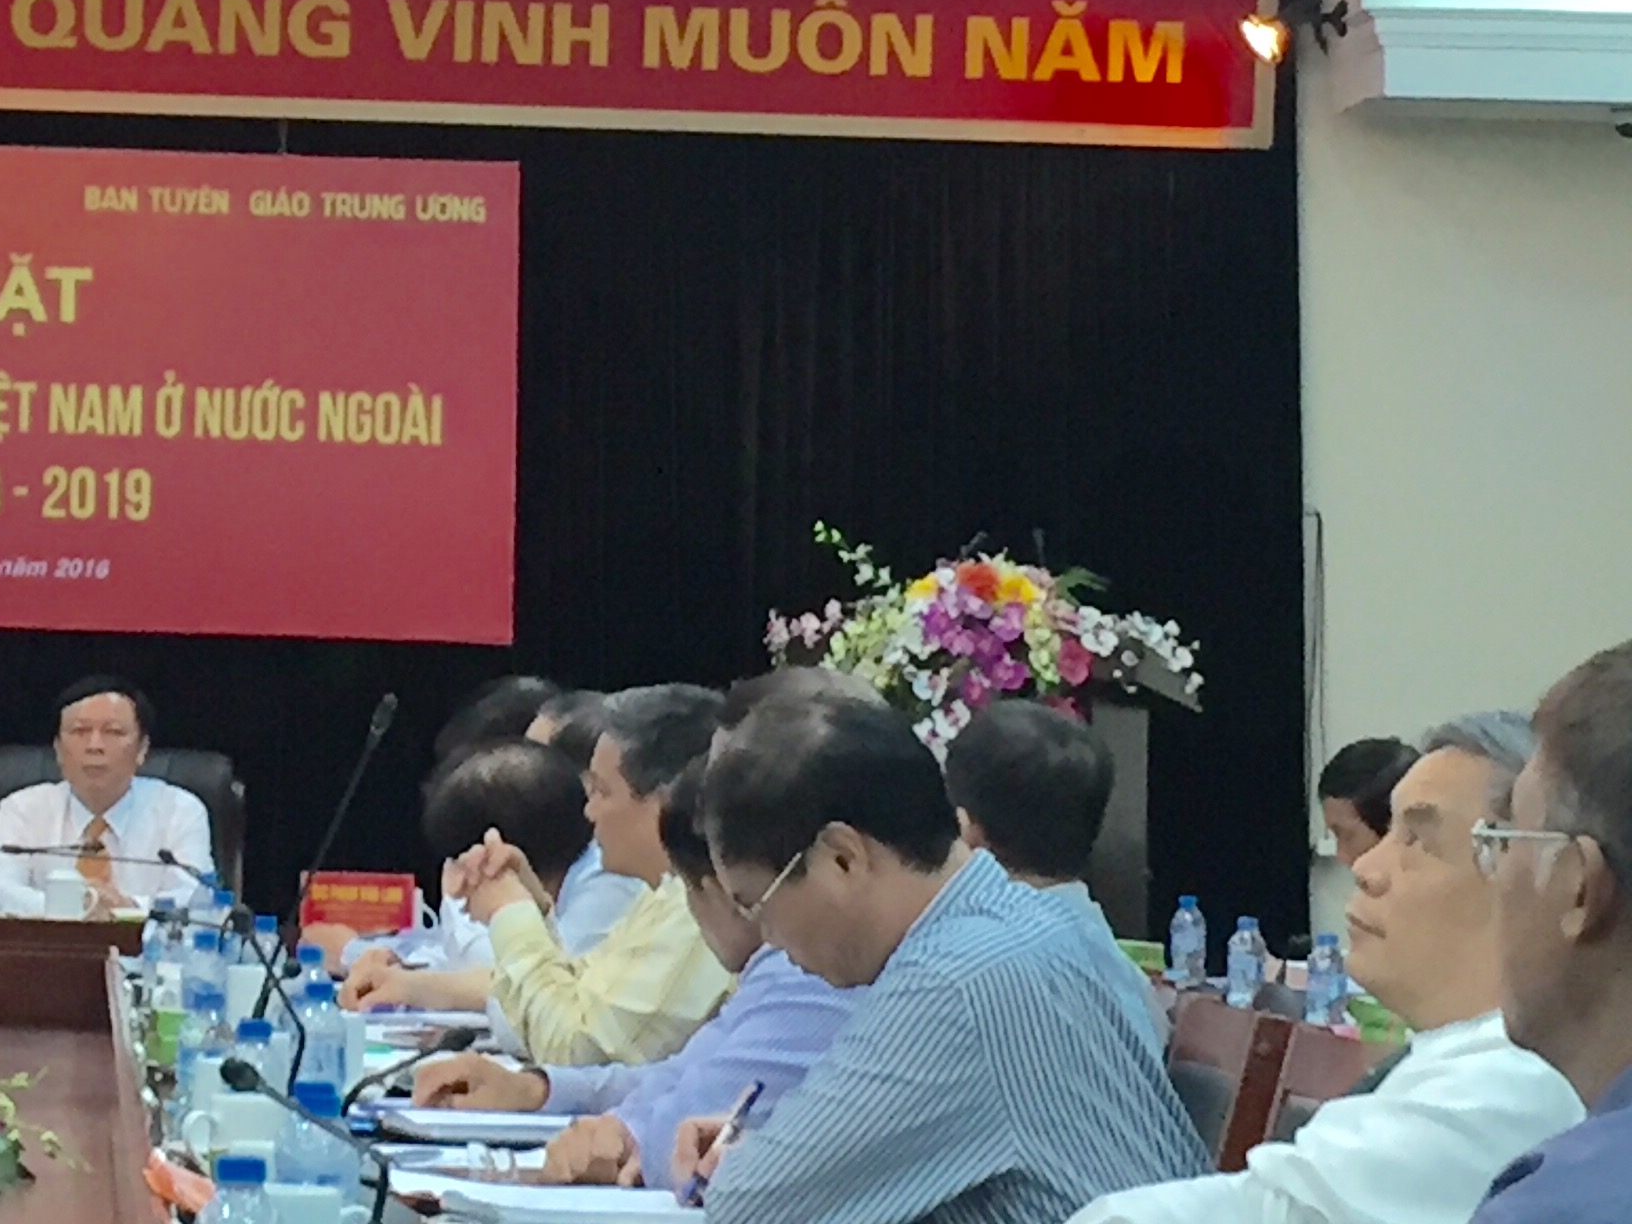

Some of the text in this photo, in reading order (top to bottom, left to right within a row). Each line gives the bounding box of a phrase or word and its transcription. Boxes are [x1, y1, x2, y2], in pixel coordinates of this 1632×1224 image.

[964, 0, 1187, 84] NĂM
[84, 186, 138, 212] BAN
[321, 192, 405, 220] TRUNG
[49, 383, 143, 436] NAM
[155, 369, 185, 438] Ở
[194, 379, 305, 442] NƯỚC
[317, 382, 444, 446] NGOÀI
[41, 465, 152, 521] 2019
[54, 557, 111, 579] 2016
